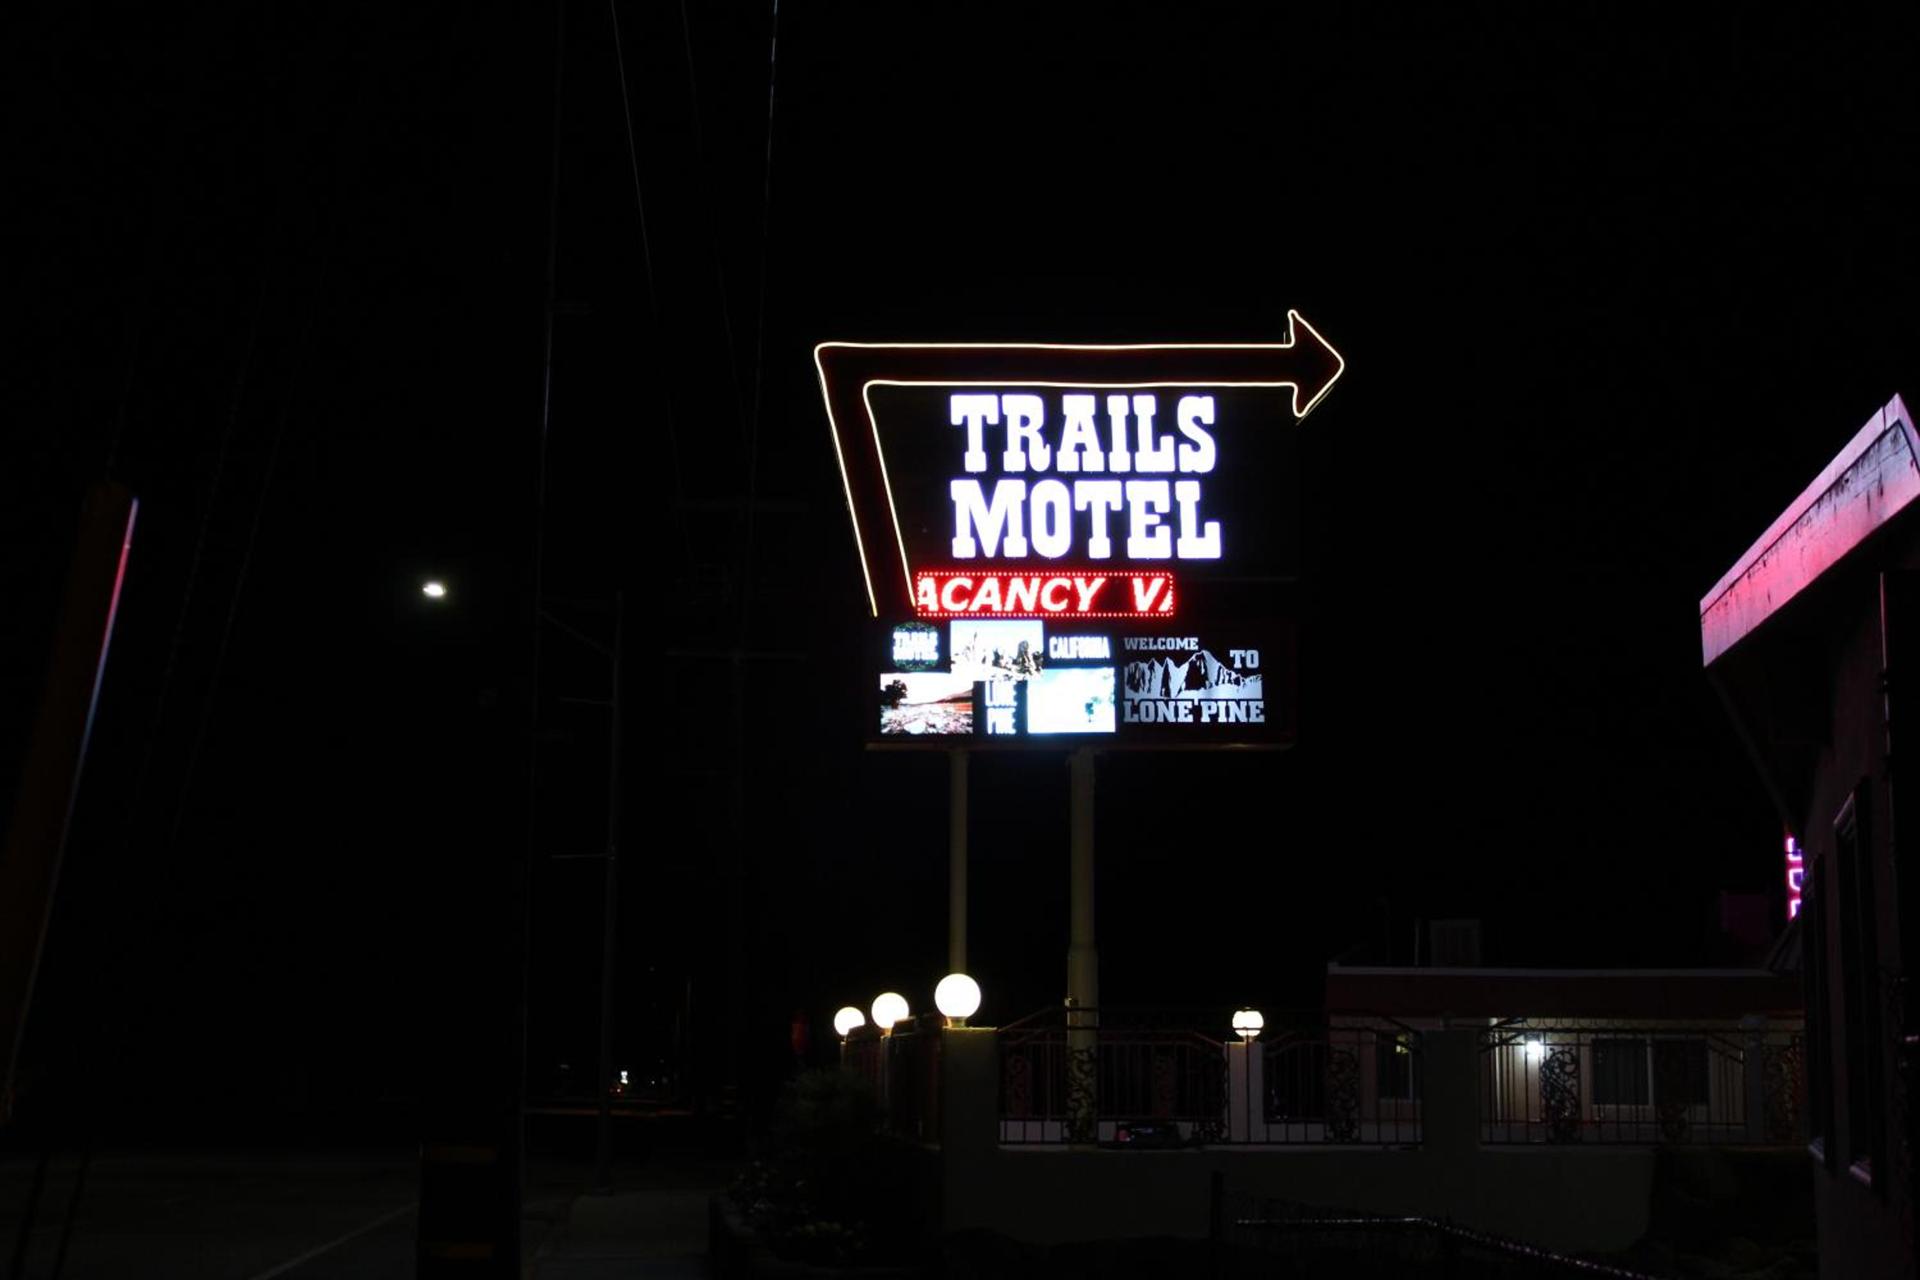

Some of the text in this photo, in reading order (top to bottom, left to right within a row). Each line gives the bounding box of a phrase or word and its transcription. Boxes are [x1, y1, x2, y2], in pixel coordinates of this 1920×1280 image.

[949, 394, 1217, 473] TRAILS
[949, 479, 1223, 560] MOTEL
[918, 577, 1106, 611] ACANCY
[1124, 637, 1199, 650] WELCOME
[1229, 649, 1259, 669] TO
[1123, 700, 1265, 723] LONE PINE
